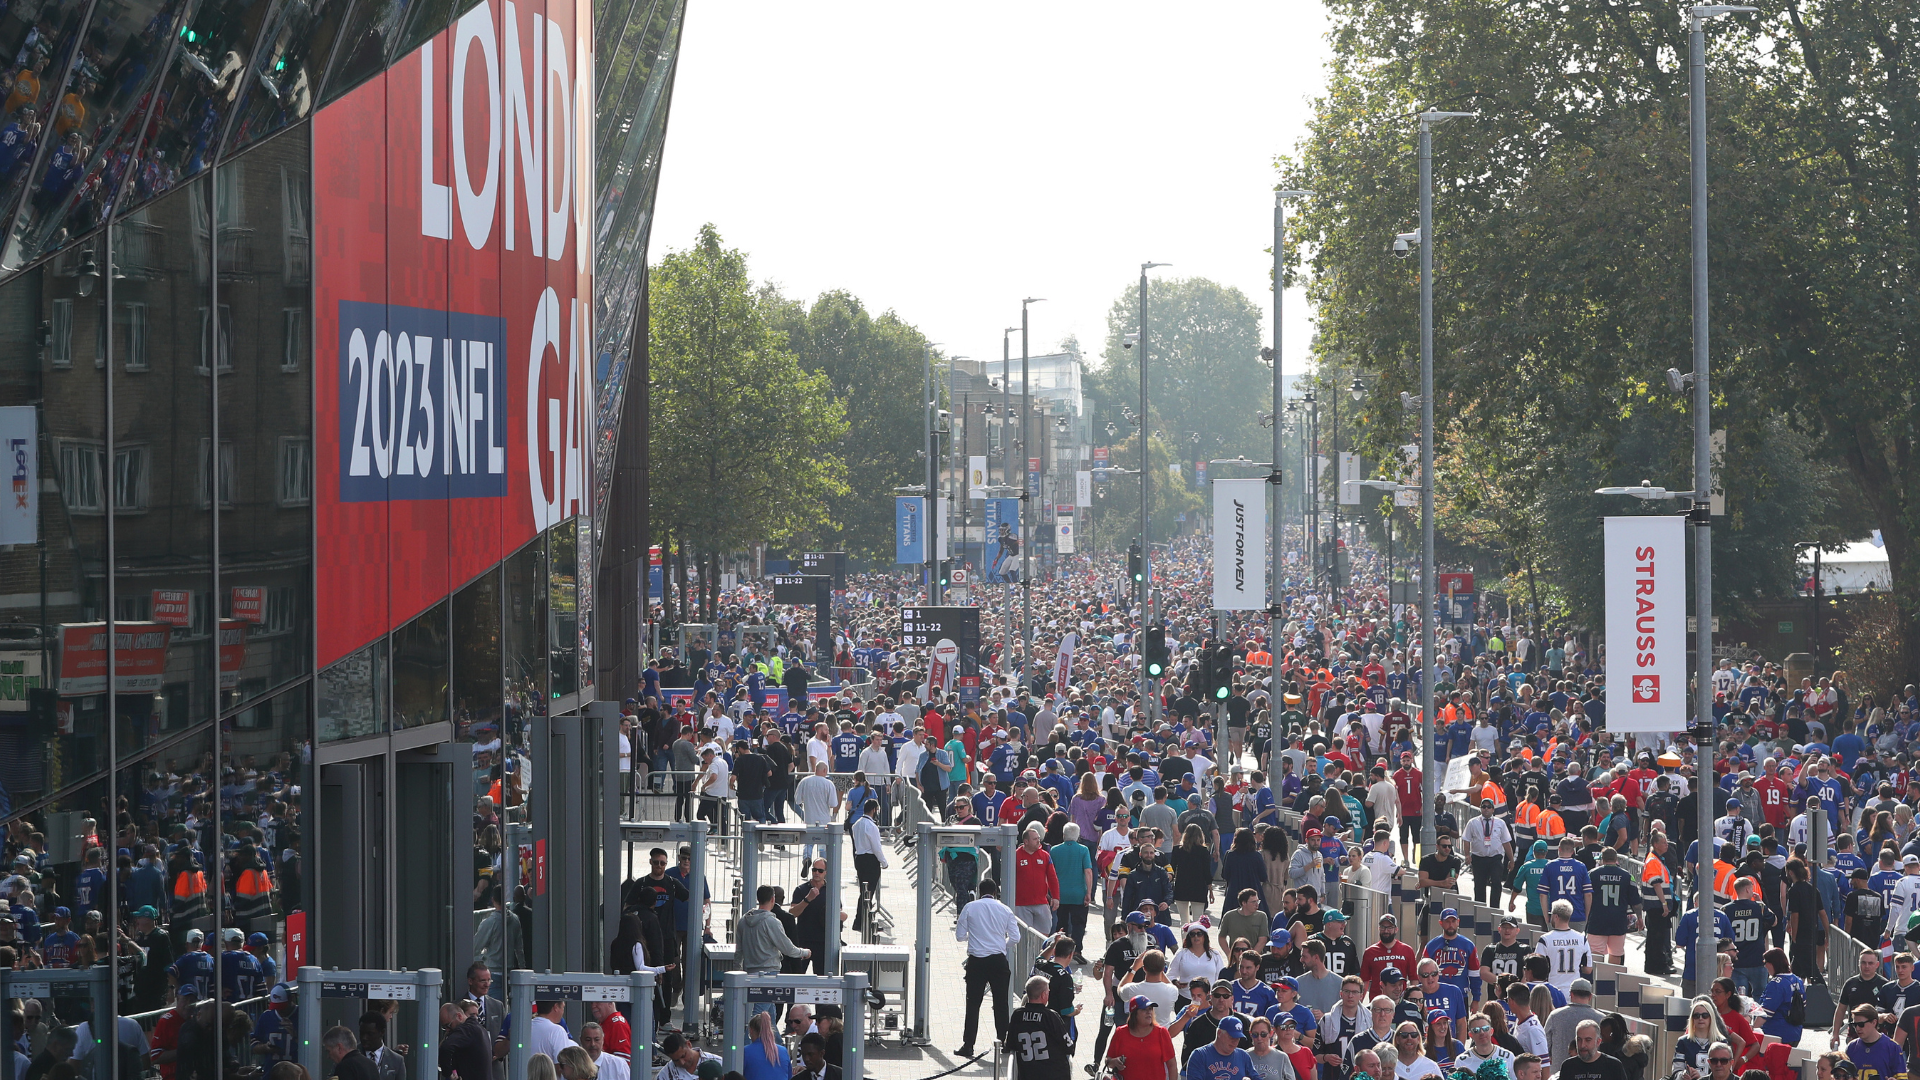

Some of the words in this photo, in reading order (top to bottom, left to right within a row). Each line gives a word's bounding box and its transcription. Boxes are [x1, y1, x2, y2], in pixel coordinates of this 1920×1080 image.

[421, 0, 593, 270] LONDO
[349, 327, 434, 478] 2023
[443, 338, 504, 475] NFL
[986, 502, 996, 544] TITANS
[1234, 499, 1244, 532] JUST
[1236, 533, 1244, 558] FOR
[1236, 558, 1244, 592] MEN
[916, 610, 922, 618] 1
[1636, 546, 1656, 668] STRAUSS
[916, 636, 927, 644] 23
[856, 654, 870, 665] 34
[710, 669, 718, 678] 88
[934, 664, 943, 679] NFL
[758, 680, 765, 690] 17
[1393, 680, 1401, 689] 17
[1719, 678, 1730, 691] 17
[1374, 694, 1384, 704] 18
[785, 724, 798, 734] 14
[799, 731, 810, 744] 36
[841, 744, 856, 757] 92
[1407, 780, 1411, 794] 1
[1818, 787, 1834, 801] 40
[1766, 789, 1780, 805] 19
[986, 806, 994, 822] 0
[1557, 875, 1576, 895] 14
[1600, 885, 1620, 906] 14
[293, 933, 301, 942] GATE
[1732, 918, 1760, 942] 30
[294, 945, 299, 961] 4
[1435, 949, 1467, 967] BILLS
[1325, 952, 1346, 973] 16
[1492, 959, 1517, 975] 60
[1557, 949, 1576, 974] 11
[1235, 1001, 1258, 1017] 17
[1893, 997, 1906, 1016] 4
[1022, 1012, 1042, 1022] ALLEN
[1018, 1031, 1049, 1062] 32
[1208, 1062, 1239, 1074] BILLS
